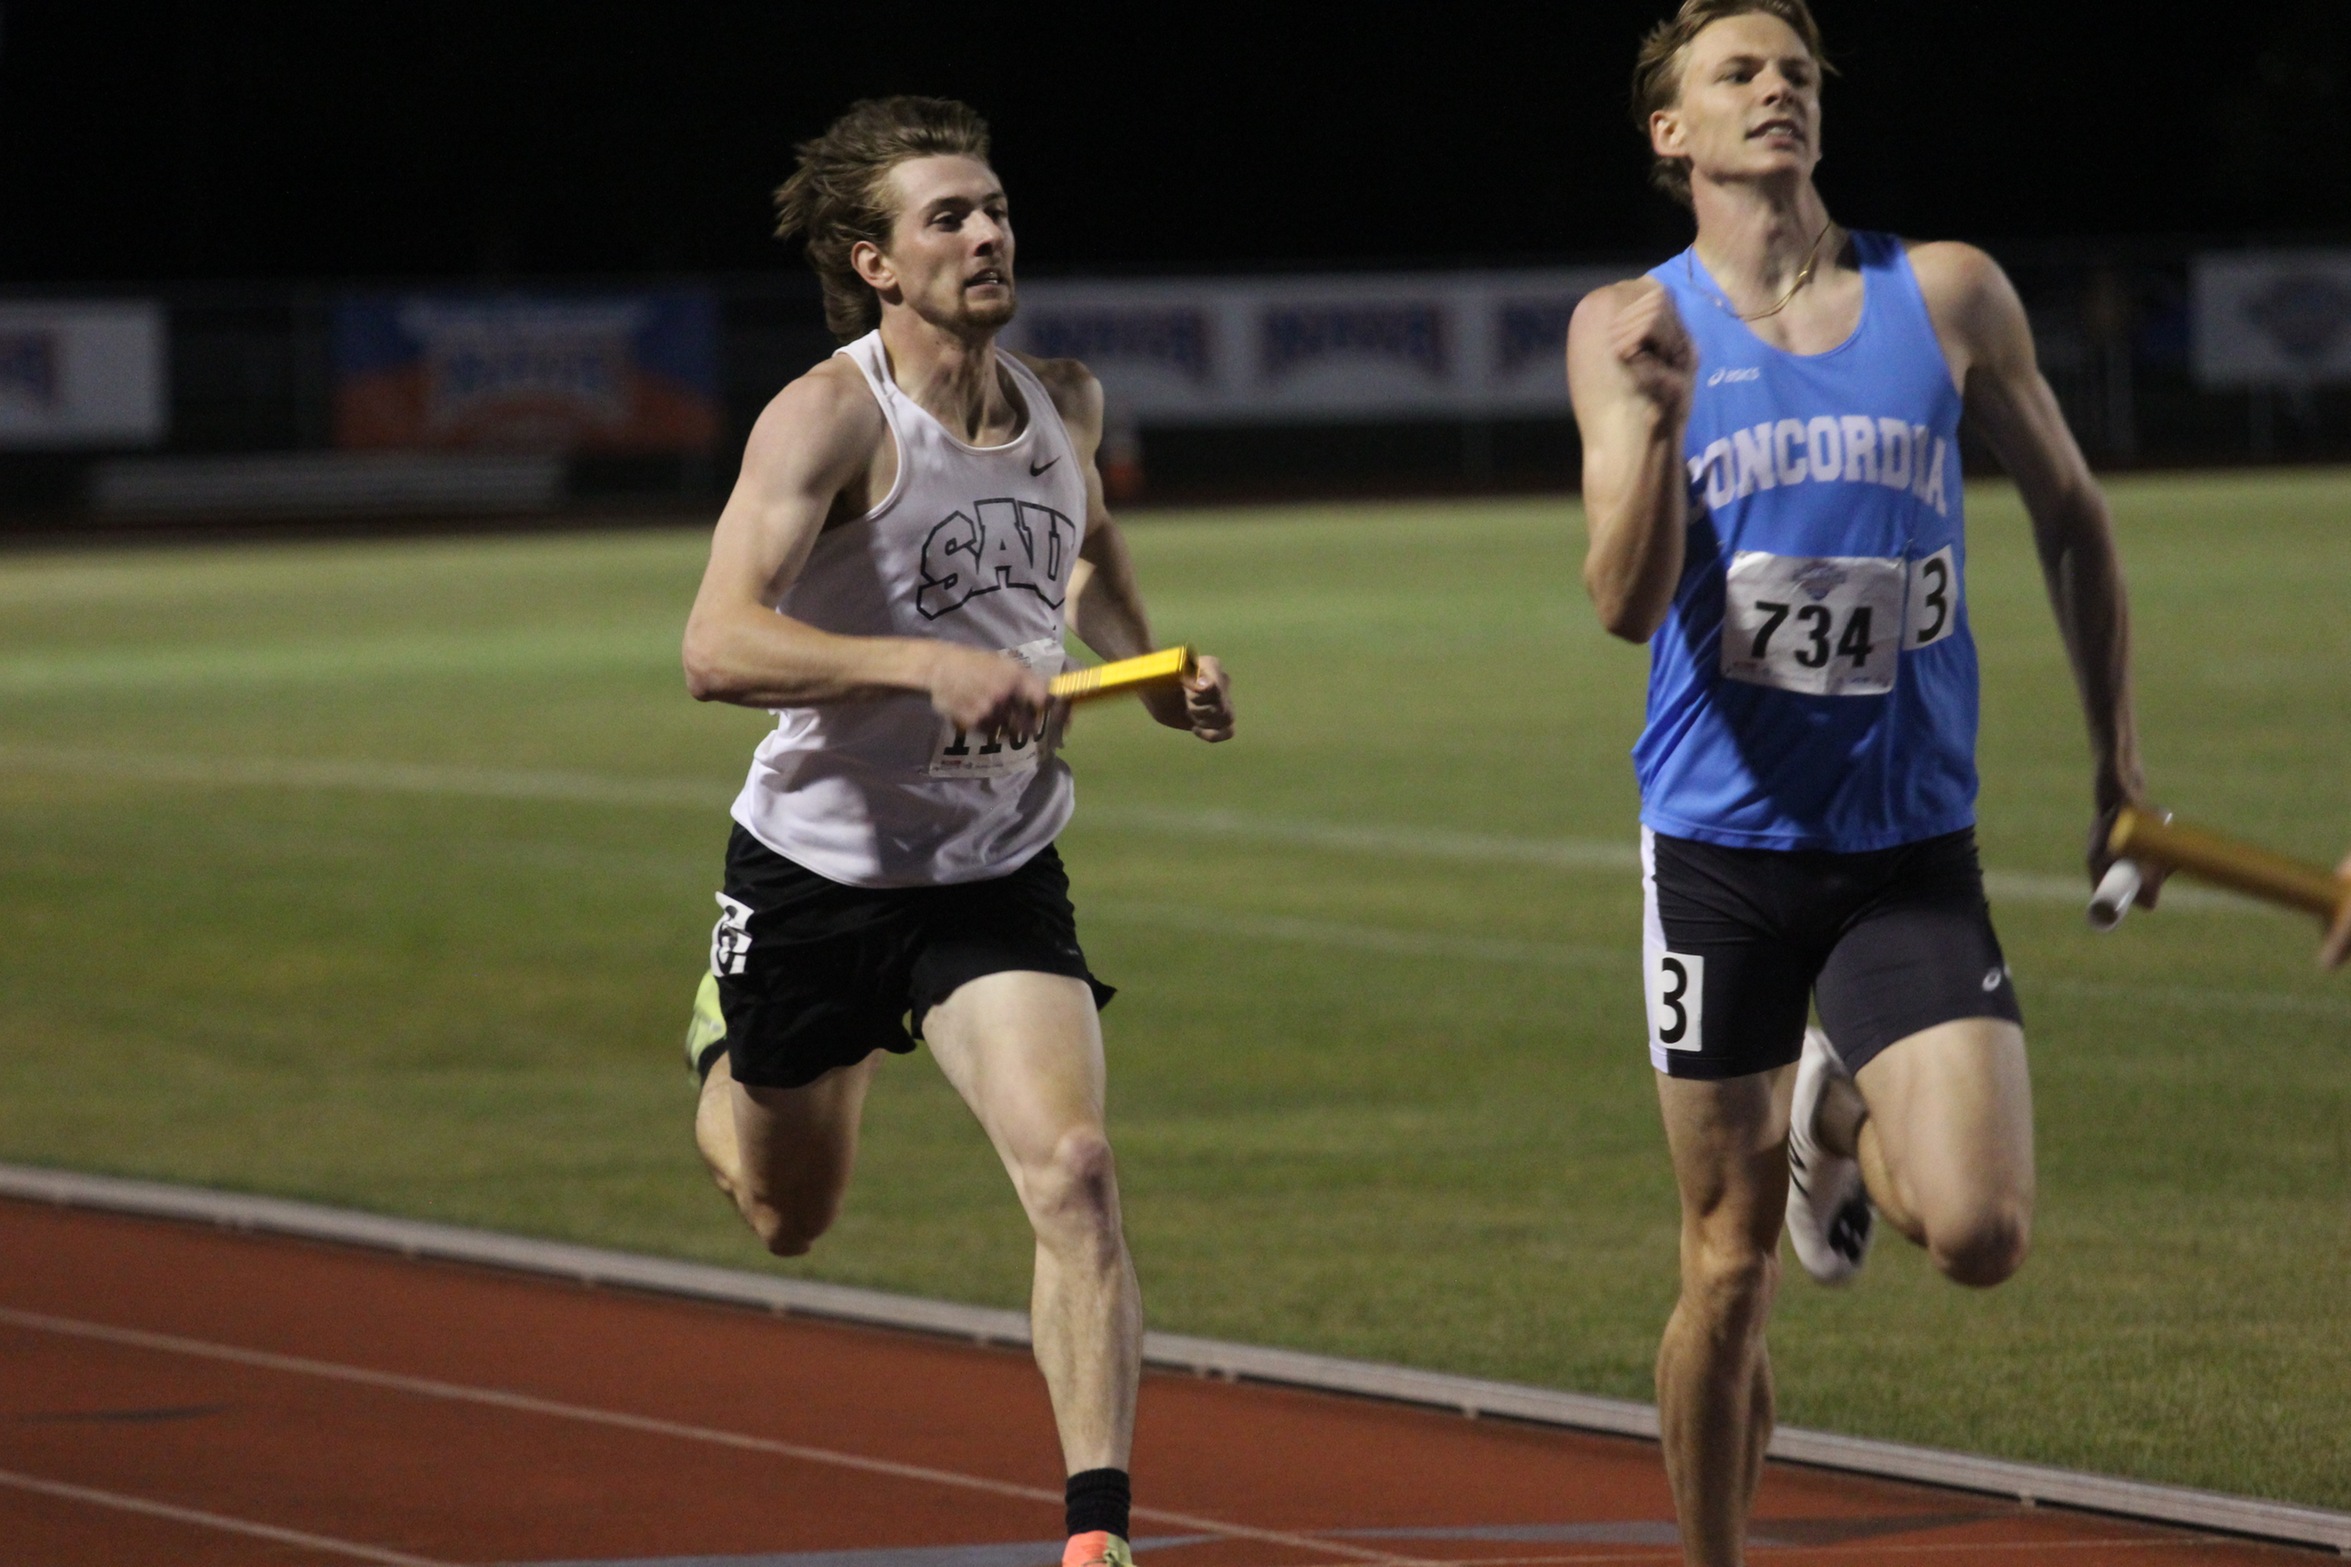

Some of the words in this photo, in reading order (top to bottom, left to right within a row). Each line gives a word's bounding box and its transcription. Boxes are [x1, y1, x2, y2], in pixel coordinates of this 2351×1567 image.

[916, 497, 1075, 621] SAU
[1917, 557, 1947, 643] 3
[1751, 600, 1873, 668] 734
[1659, 957, 1688, 1044] 3
